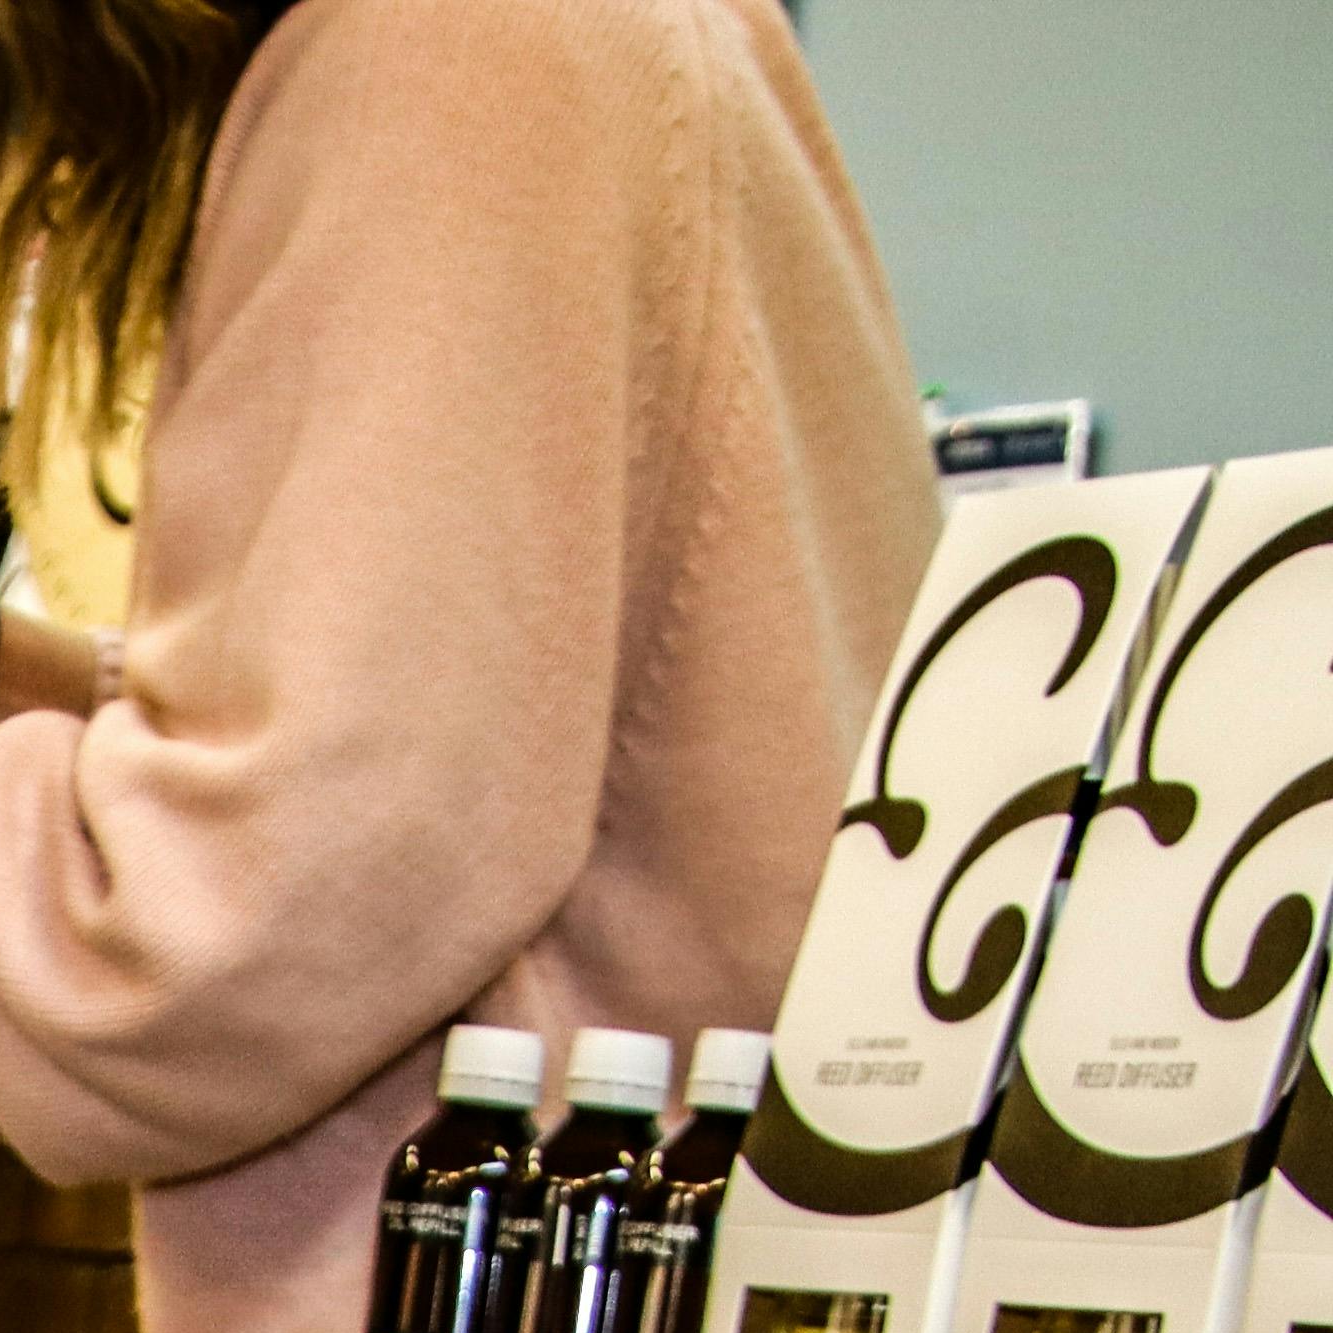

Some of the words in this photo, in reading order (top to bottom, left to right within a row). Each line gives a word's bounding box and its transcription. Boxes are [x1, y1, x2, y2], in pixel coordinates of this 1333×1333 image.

[815, 1060, 849, 1086] REED
[852, 1061, 924, 1087] DIFFUSER
[1073, 1061, 1110, 1088] REED
[1117, 1062, 1198, 1089] DIFFUSER
